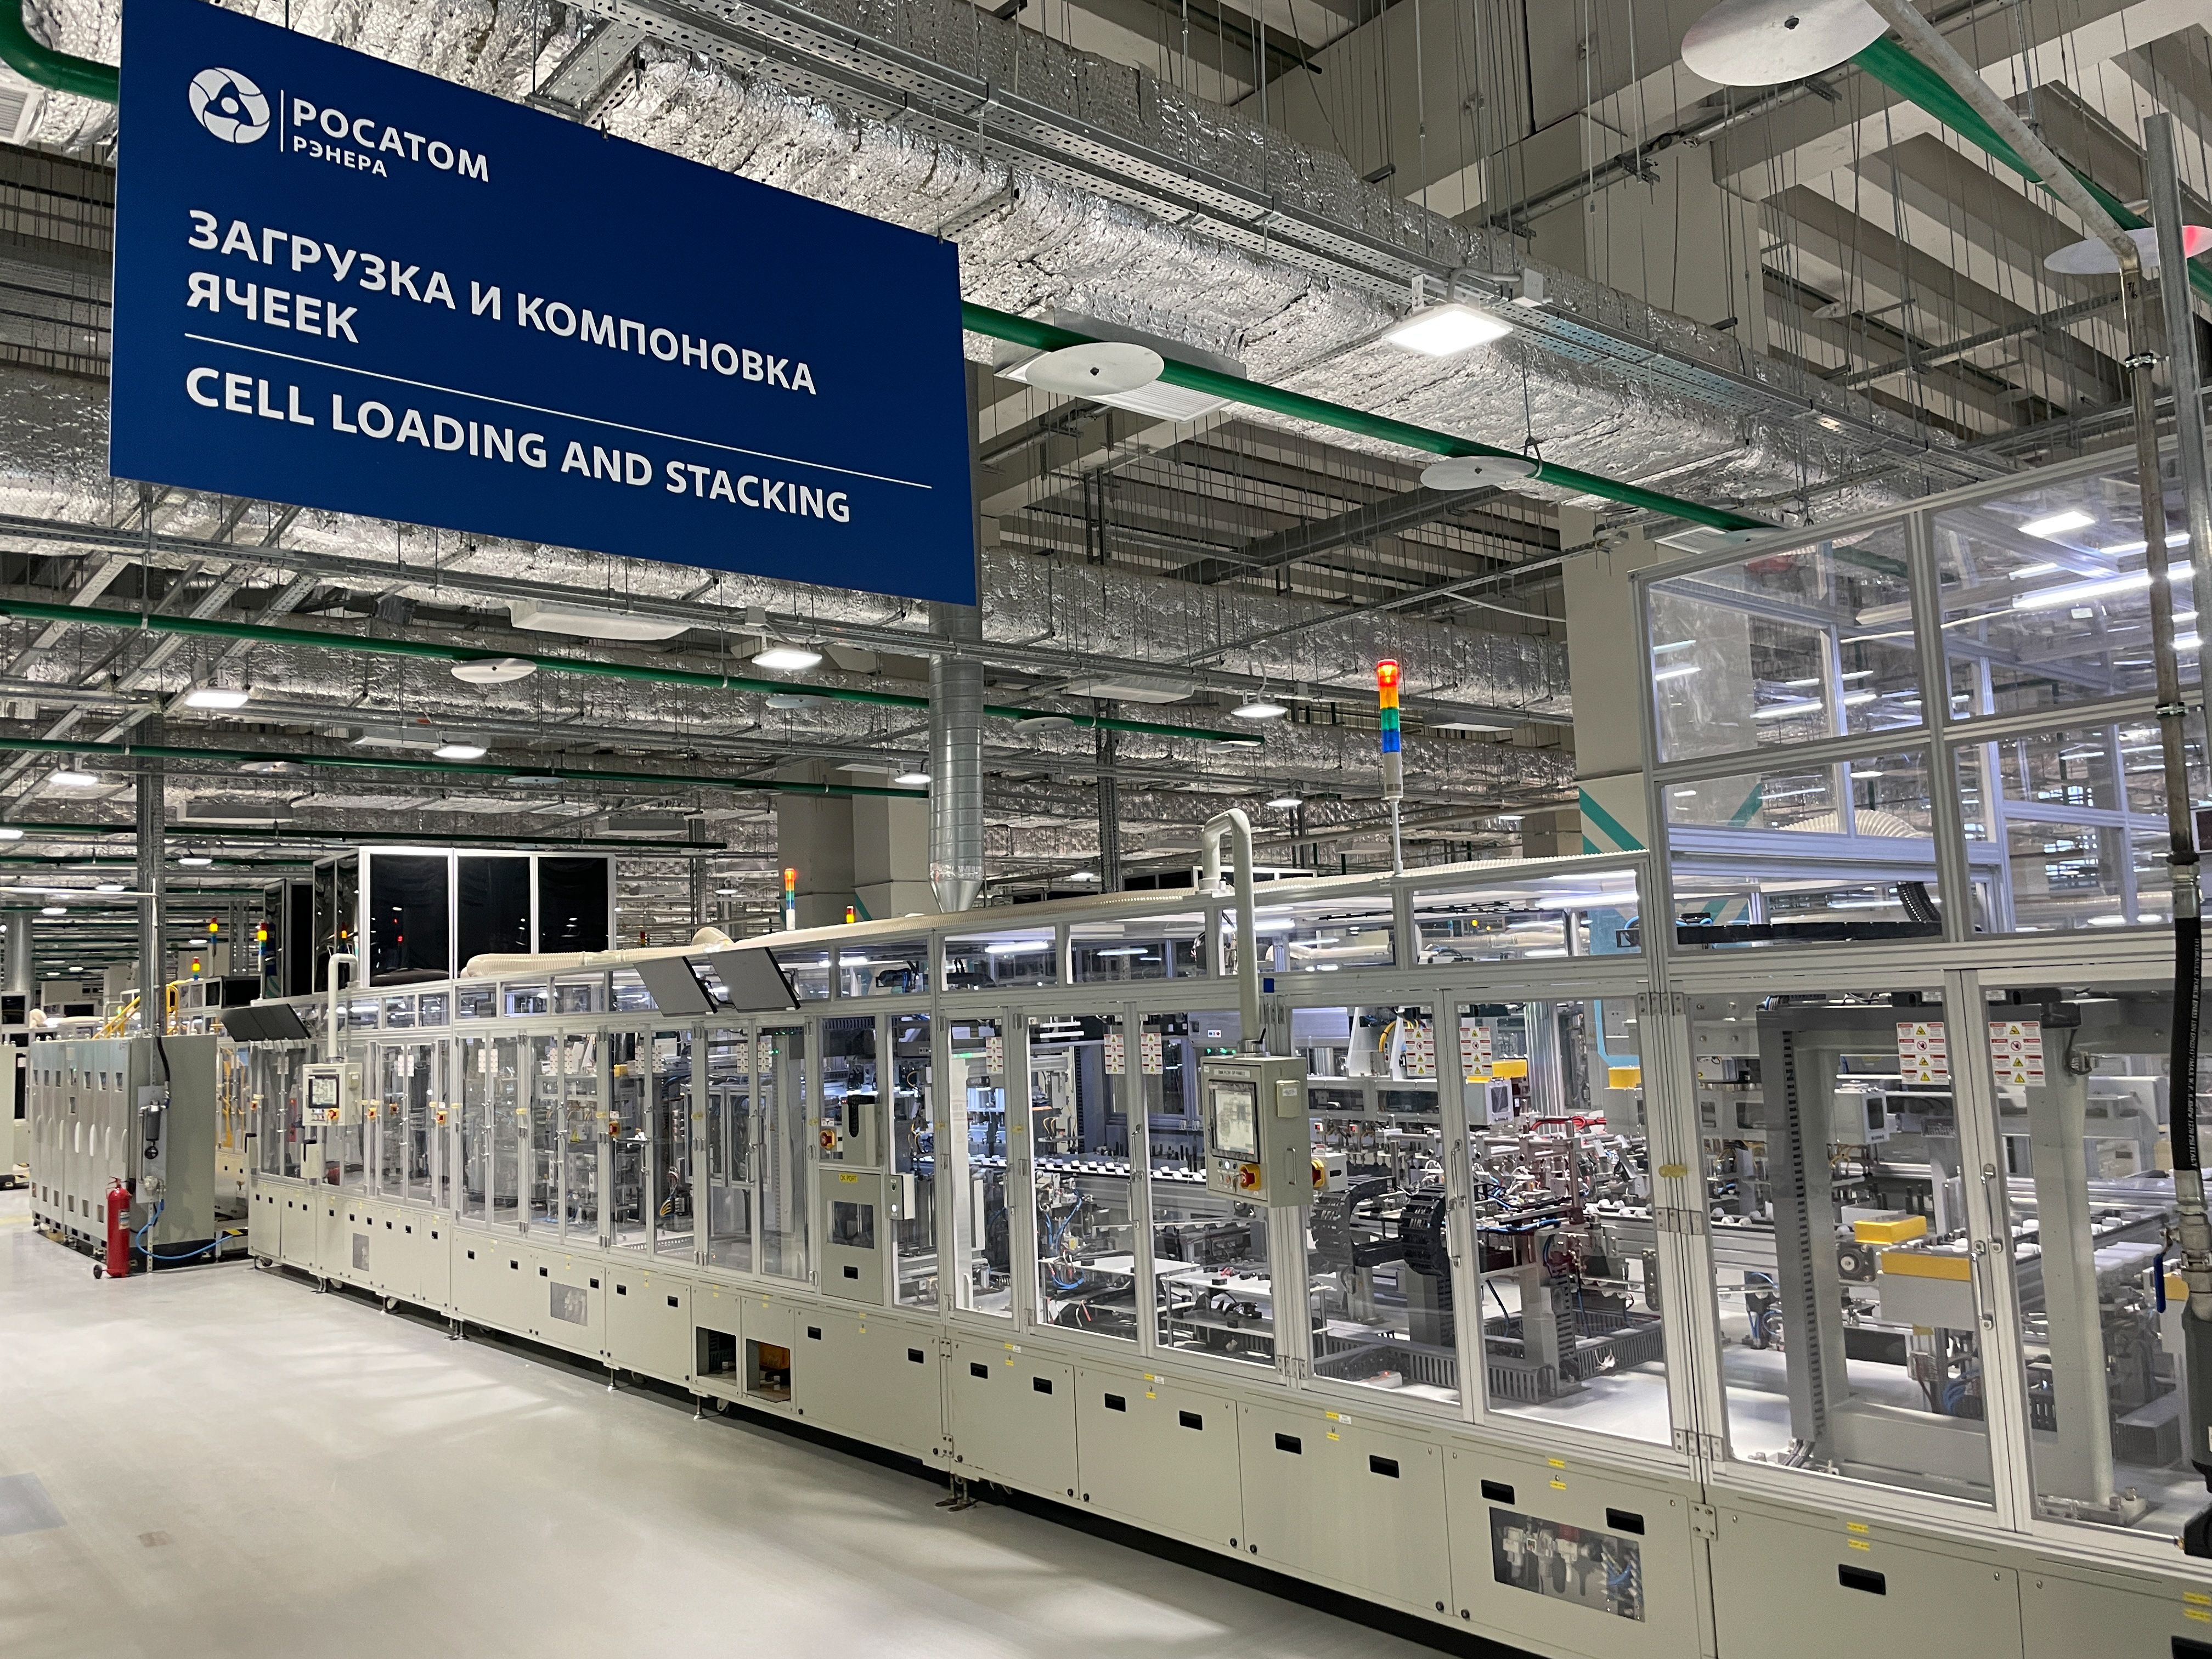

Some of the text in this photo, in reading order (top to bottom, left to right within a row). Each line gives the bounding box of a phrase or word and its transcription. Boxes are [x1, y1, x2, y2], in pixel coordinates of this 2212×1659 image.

[293, 97, 489, 183] РОСАТОМ
[293, 135, 388, 178] РЭНЕРА
[187, 272, 359, 344] ЯЧЕЕК
[188, 210, 817, 396] ЗАГРУЗКА И КОМПОНОВКА
[187, 367, 850, 523] CELL LOADING AND STACKING
[2189, 1147, 2199, 1167] ITALY
